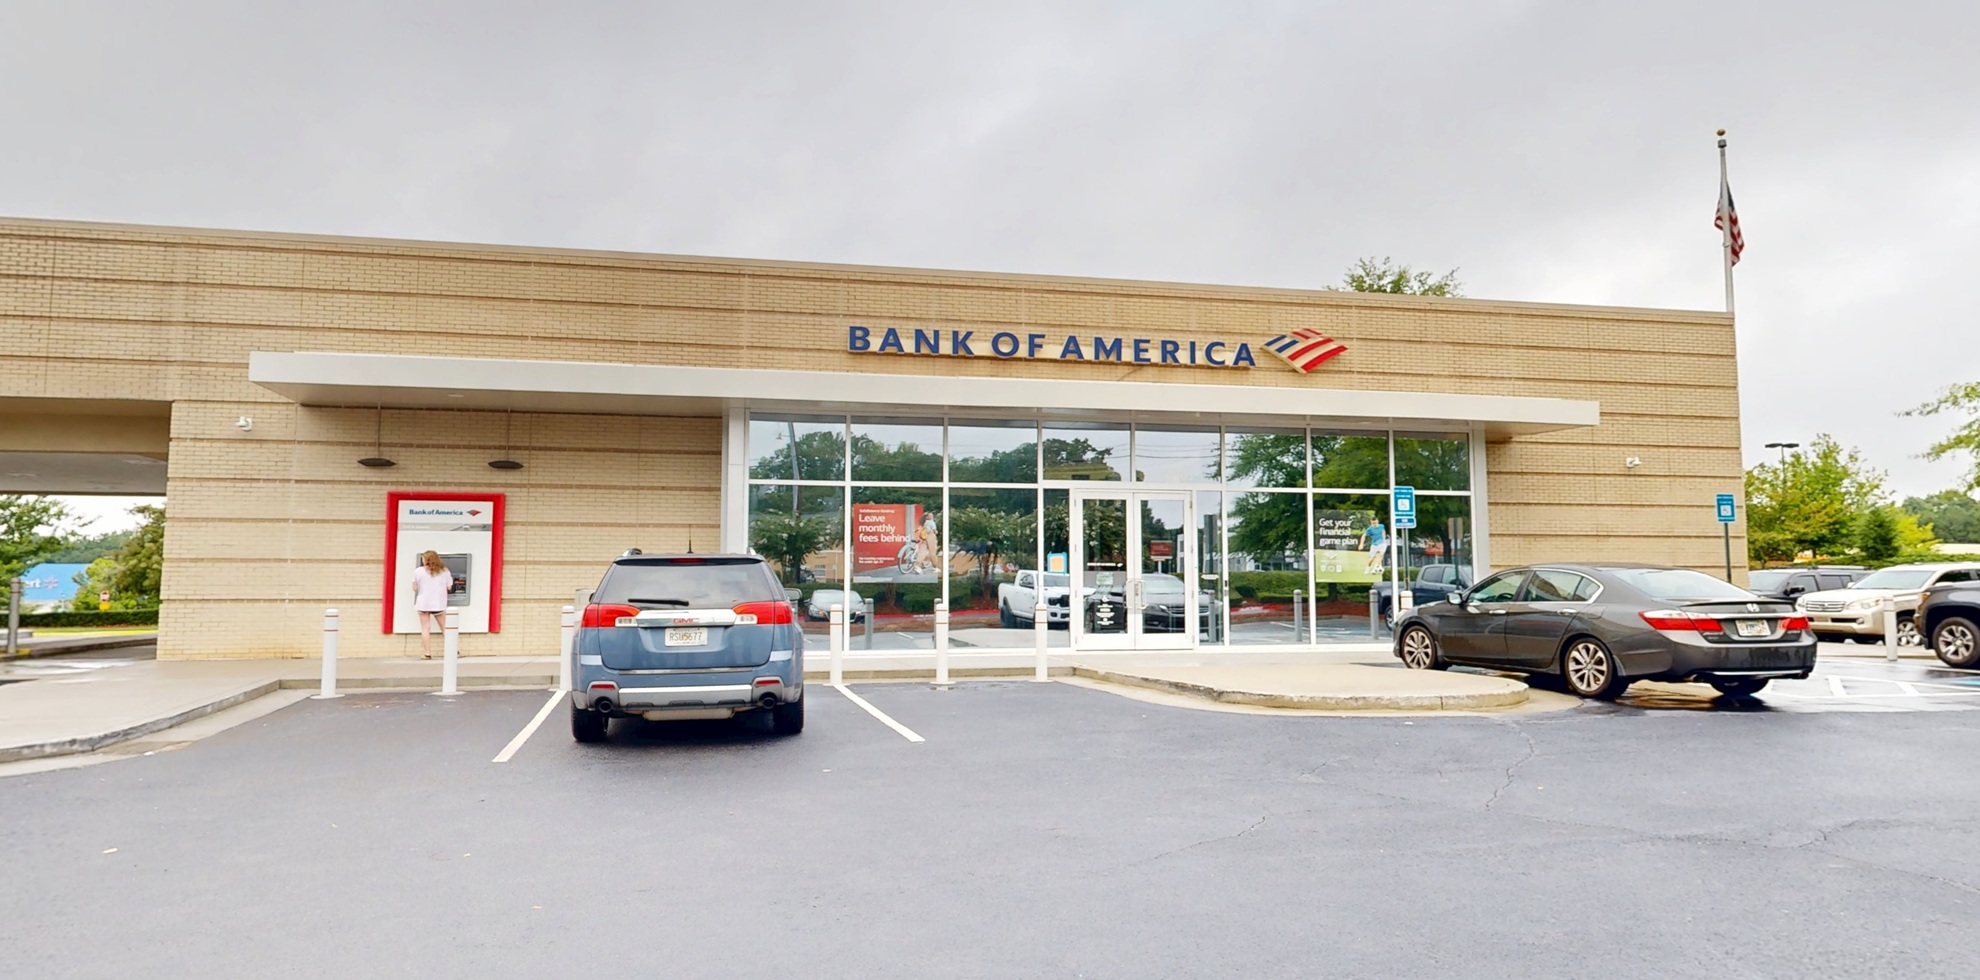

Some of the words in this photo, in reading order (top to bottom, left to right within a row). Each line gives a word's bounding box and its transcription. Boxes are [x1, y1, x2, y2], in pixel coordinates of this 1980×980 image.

[848, 325, 975, 356] BANK
[991, 332, 1047, 358] OF
[1059, 335, 1256, 367] AMERICA
[859, 514, 886, 522] Leave
[1319, 518, 1334, 527] Get
[1335, 519, 1352, 529] your
[859, 524, 896, 534] monthly
[1320, 527, 1351, 535] financial
[859, 533, 879, 542] fees
[880, 533, 911, 542] behind
[1319, 538, 1341, 547] game
[1342, 537, 1358, 546] plan
